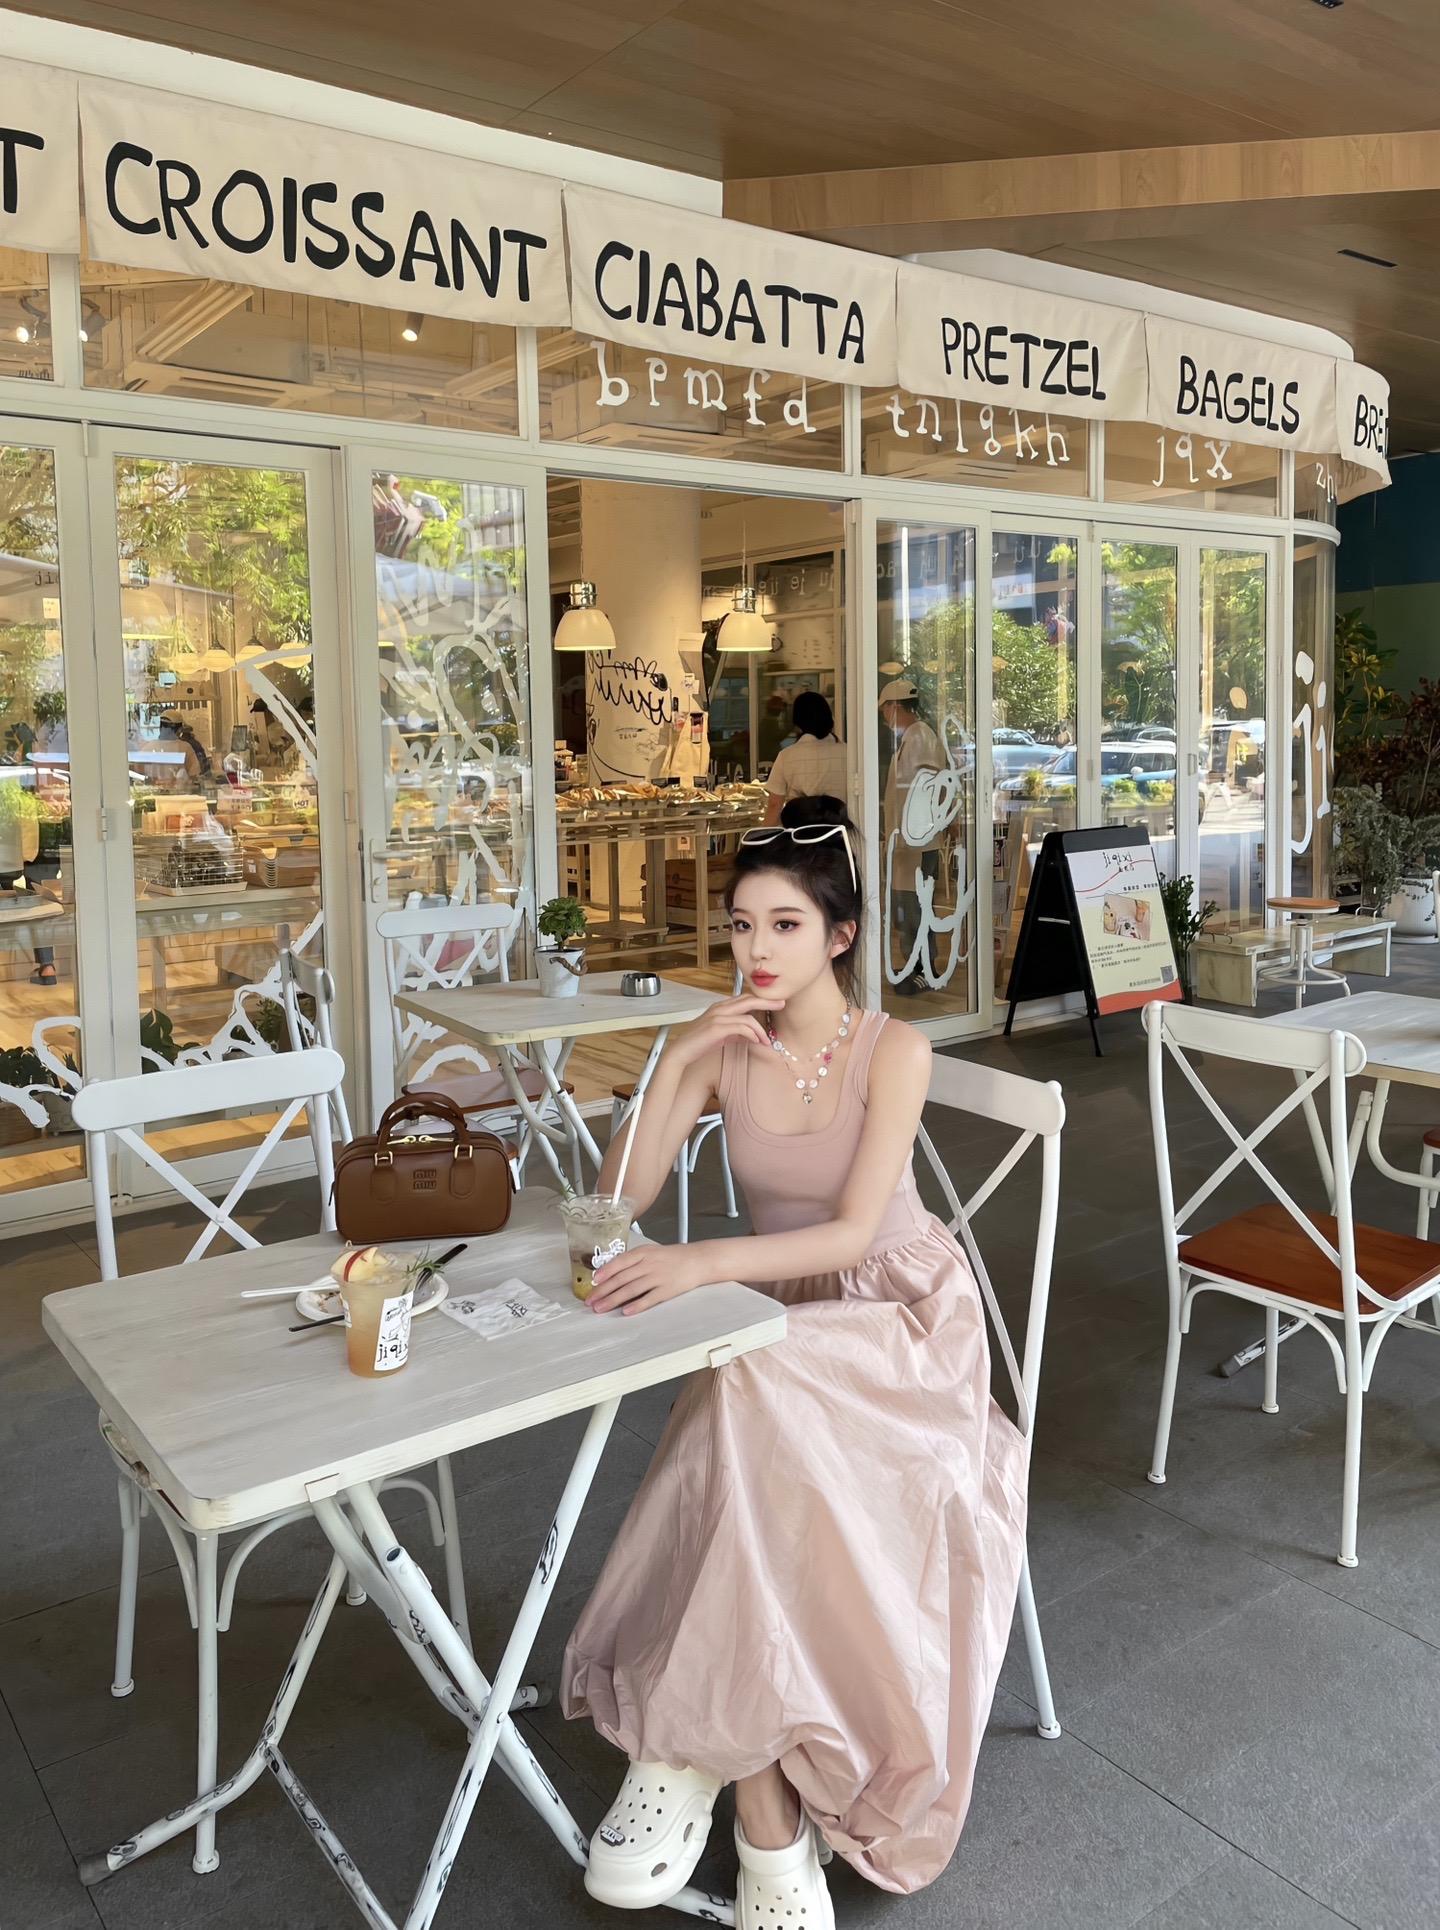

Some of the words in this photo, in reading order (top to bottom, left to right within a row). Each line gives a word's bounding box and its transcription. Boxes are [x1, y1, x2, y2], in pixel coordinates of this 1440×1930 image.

[104, 141, 548, 302] CROISSANT
[595, 240, 865, 364] CIABATTA
[940, 317, 1107, 401] PRETZEL
[1176, 355, 1300, 434] BAGELS
